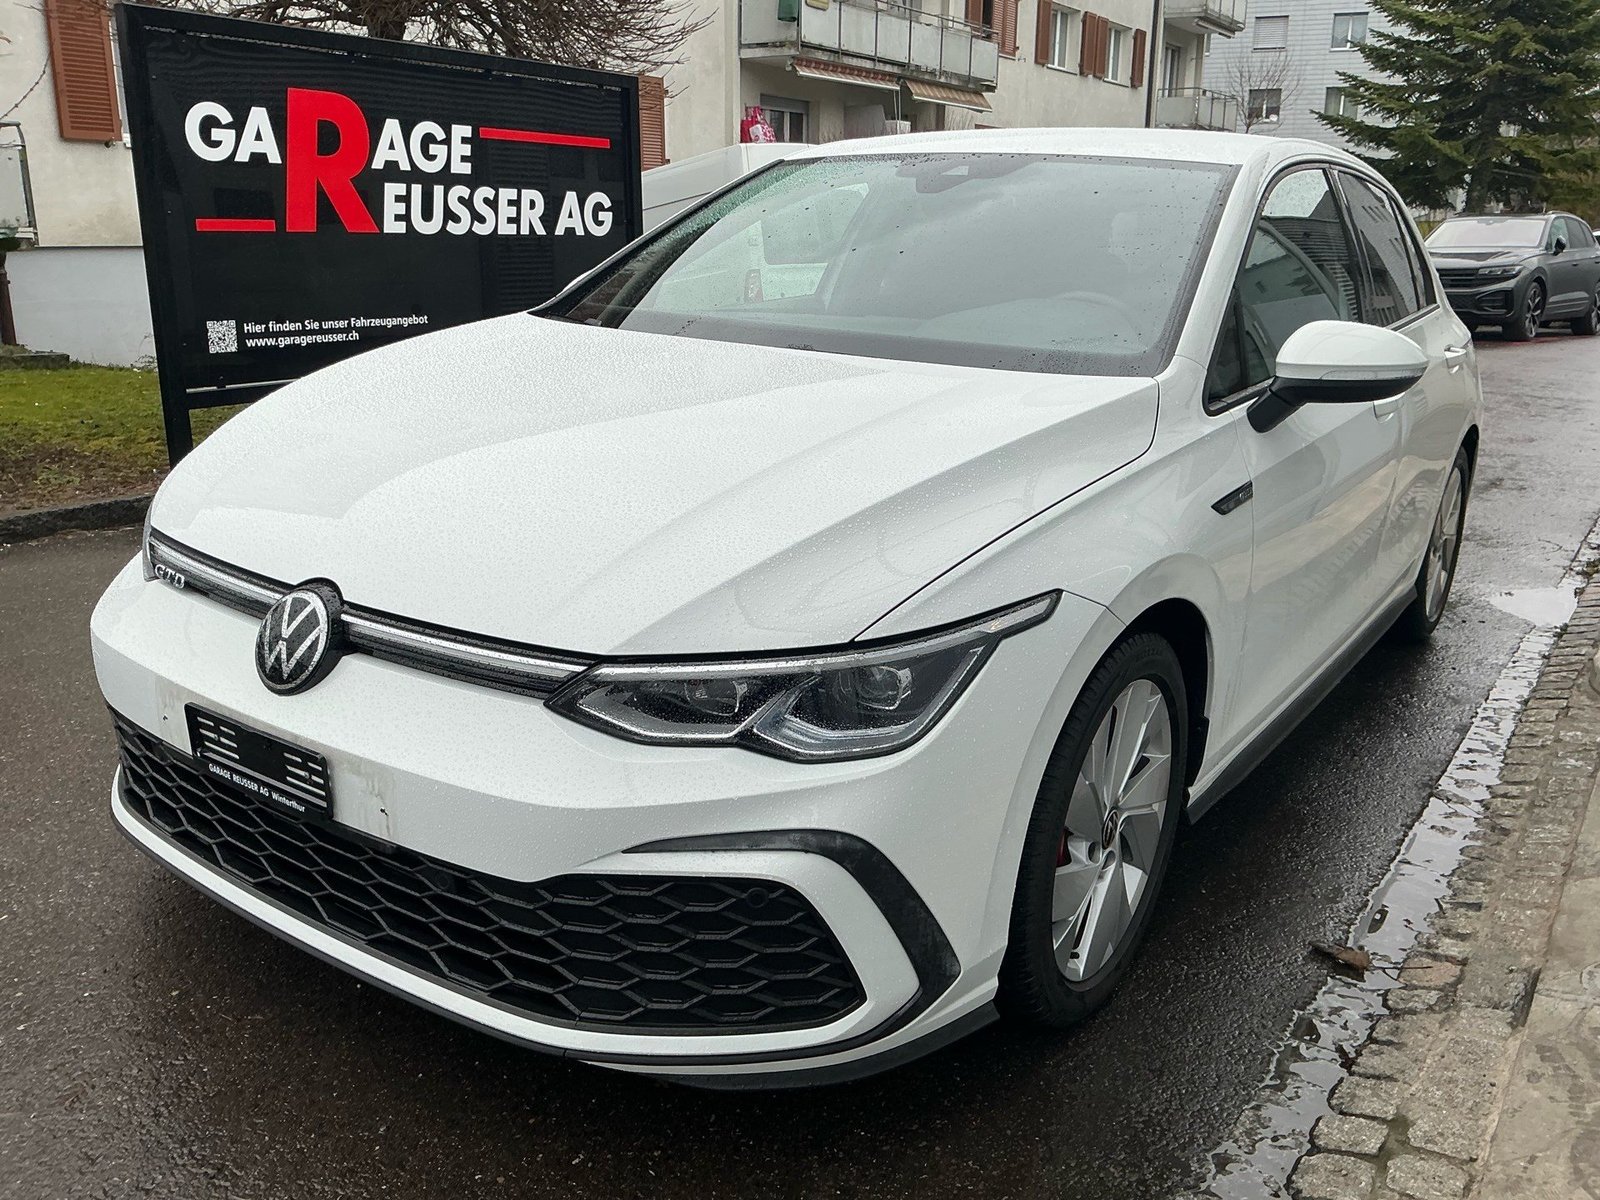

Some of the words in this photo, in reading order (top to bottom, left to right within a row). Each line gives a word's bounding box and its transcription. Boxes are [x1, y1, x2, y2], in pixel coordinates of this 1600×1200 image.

[185, 87, 472, 233] GARAGE
[555, 191, 613, 236] AG
[243, 321, 266, 333] Hier
[269, 319, 301, 331] finden
[304, 318, 320, 330] Sie
[322, 318, 349, 329] unser
[351, 314, 428, 328] Fahrzeugangebot
[245, 331, 359, 347] www.garagereusser.ch
[155, 564, 185, 589] GTD
[208, 763, 231, 779] GARAGE
[232, 773, 259, 792] REUSSER
[259, 785, 270, 797] AG
[271, 791, 305, 812] Winterthur
